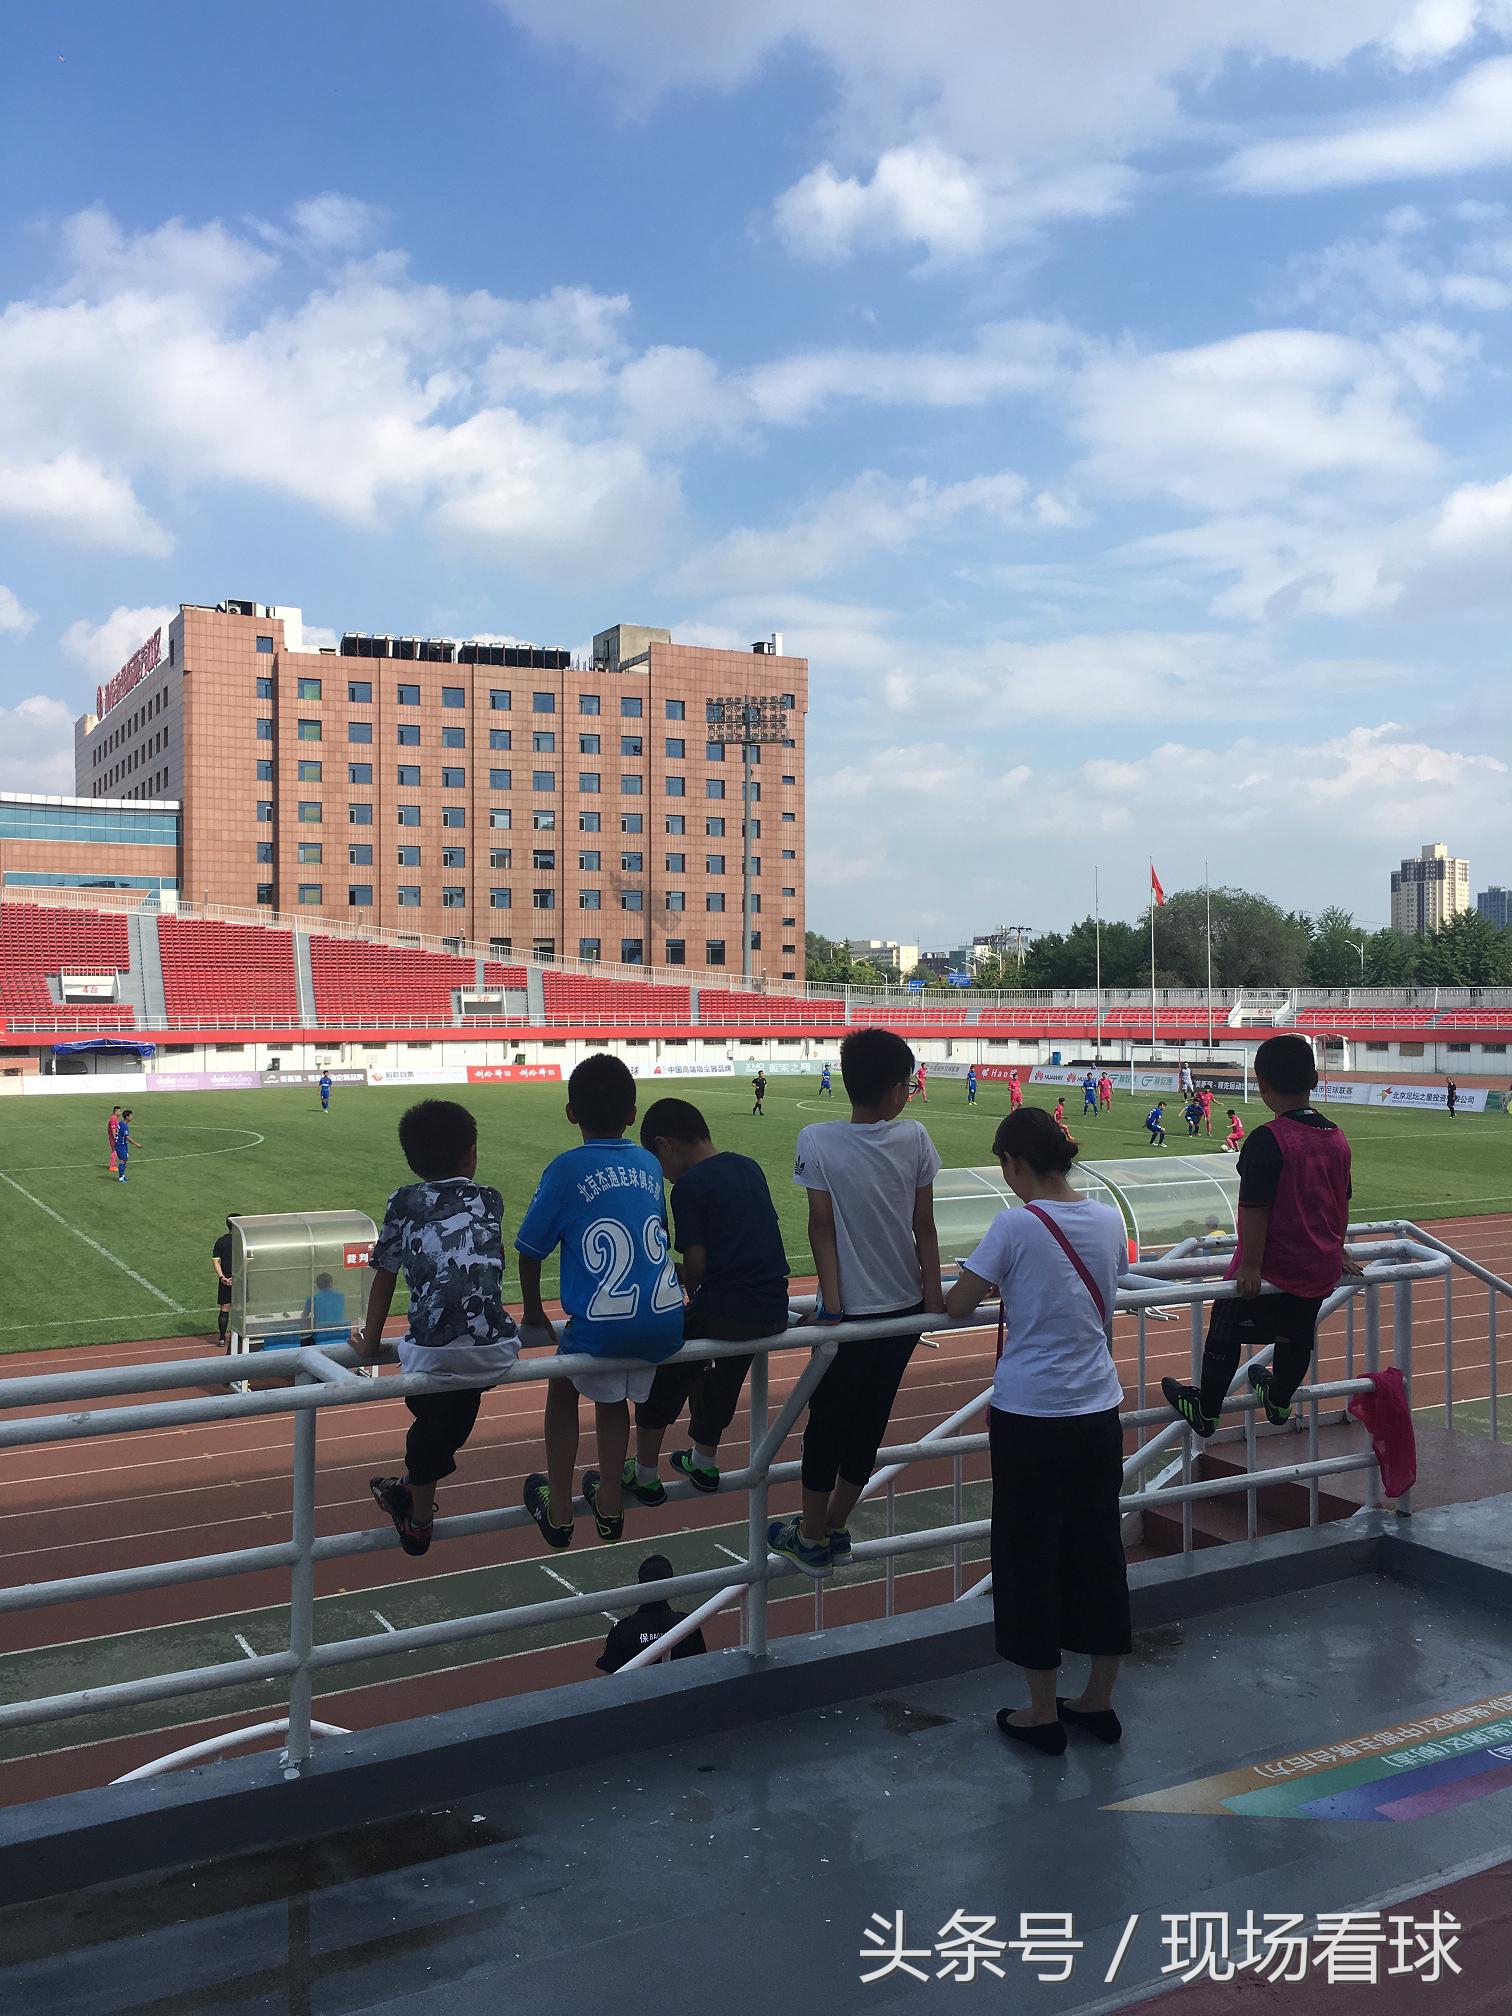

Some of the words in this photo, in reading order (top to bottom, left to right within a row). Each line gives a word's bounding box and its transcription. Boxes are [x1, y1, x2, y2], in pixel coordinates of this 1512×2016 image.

[667, 1065, 732, 1074] 中国高端吸尘器品牌
[1392, 1091, 1475, 1105] 北京足坛之星投资限公司
[576, 1166, 661, 1203] 北京杰通足球俱乐部
[581, 1214, 685, 1322] 22
